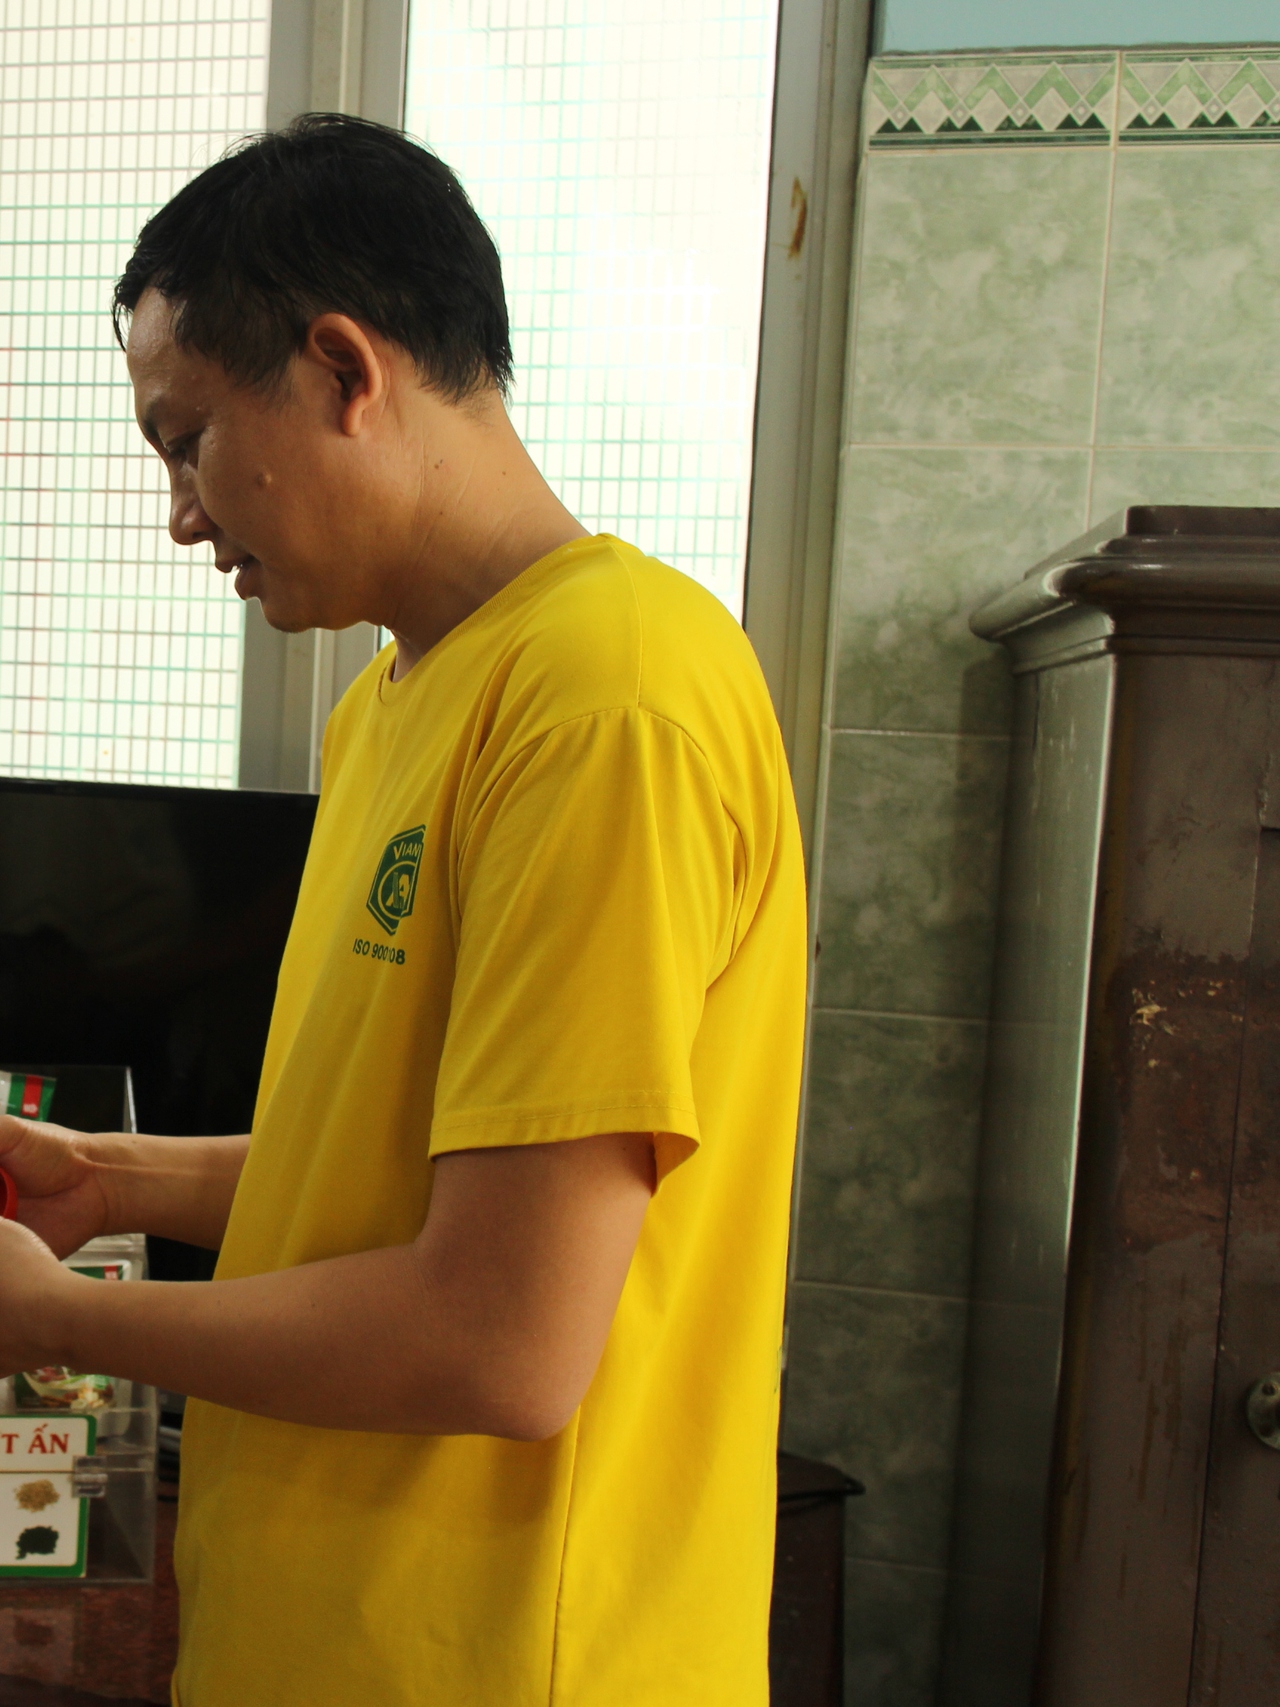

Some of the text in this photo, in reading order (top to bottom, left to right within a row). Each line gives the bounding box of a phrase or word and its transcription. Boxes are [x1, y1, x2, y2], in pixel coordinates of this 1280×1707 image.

[393, 841, 422, 860] VIAN
[352, 938, 371, 956] ISO
[27, 1423, 70, 1454] ẤN
